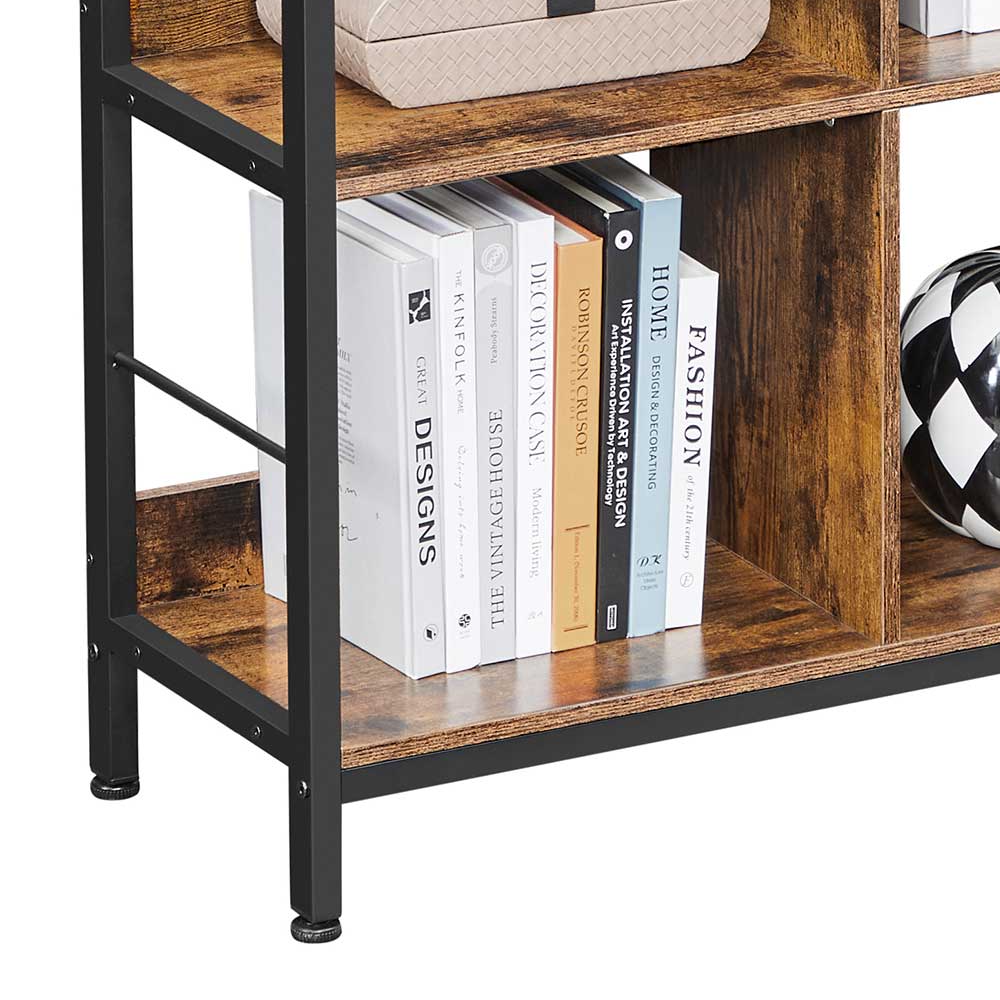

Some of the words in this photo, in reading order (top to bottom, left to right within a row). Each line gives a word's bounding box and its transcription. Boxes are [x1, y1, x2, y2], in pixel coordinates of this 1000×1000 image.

[455, 269, 463, 288] THE
[649, 264, 671, 343] HOME
[453, 293, 467, 386] KINFOLK
[528, 262, 547, 407] DECORATION
[576, 287, 591, 381] ROBINSON
[610, 324, 620, 341] Art
[618, 298, 633, 414] INSTALLATION
[415, 355, 429, 405] GREAT
[608, 341, 620, 398] Experience
[650, 355, 662, 399] DESIGN
[456, 389, 465, 415] HOME
[575, 384, 589, 457] CRUSOE
[608, 398, 618, 432] Driven
[650, 402, 661, 412] &
[683, 324, 708, 467] FASHION
[488, 409, 504, 485] HOUSE
[528, 410, 546, 466] CASE
[606, 433, 617, 446] by
[617, 417, 630, 448] ART
[617, 451, 629, 465] &
[647, 414, 661, 491] DECORATING
[415, 417, 437, 567] DESIGNS
[603, 447, 616, 507] Technology
[614, 467, 629, 529] DESIGN
[686, 488, 697, 504] the
[687, 475, 696, 486] of
[489, 487, 504, 581] VINTAGE
[529, 487, 543, 538] Modern
[529, 540, 543, 578] living
[682, 523, 694, 560] century
[490, 585, 505, 630] THE
